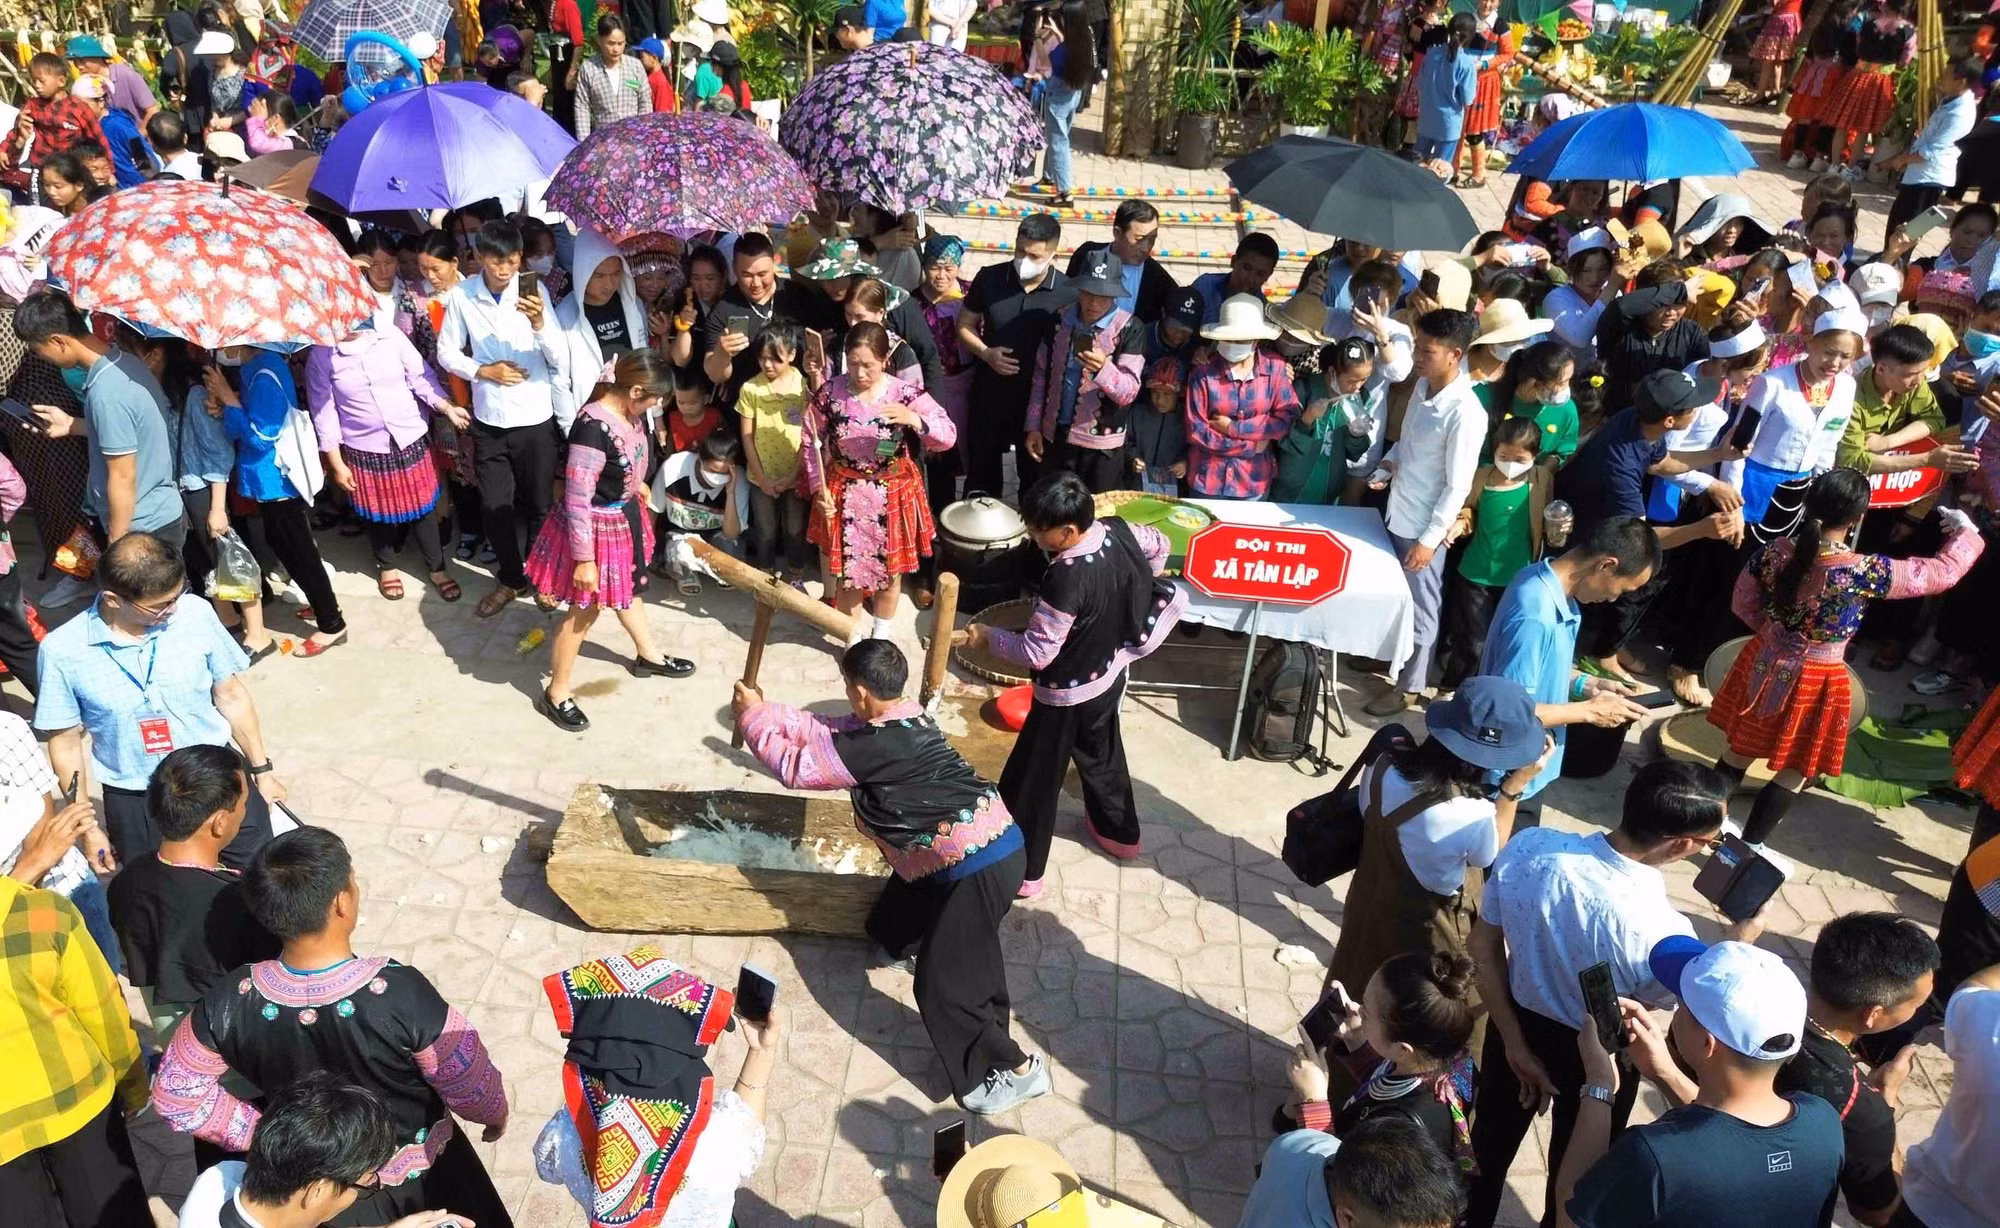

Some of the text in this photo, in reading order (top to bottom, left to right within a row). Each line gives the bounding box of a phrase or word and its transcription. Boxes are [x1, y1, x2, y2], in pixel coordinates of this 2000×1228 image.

[597, 320, 620, 333] QUEEN
[1885, 469, 1922, 493] HỢP
[1235, 538, 1306, 555] ĐỘI THI
[1212, 557, 1319, 589] XÃ TÂN LẬP
